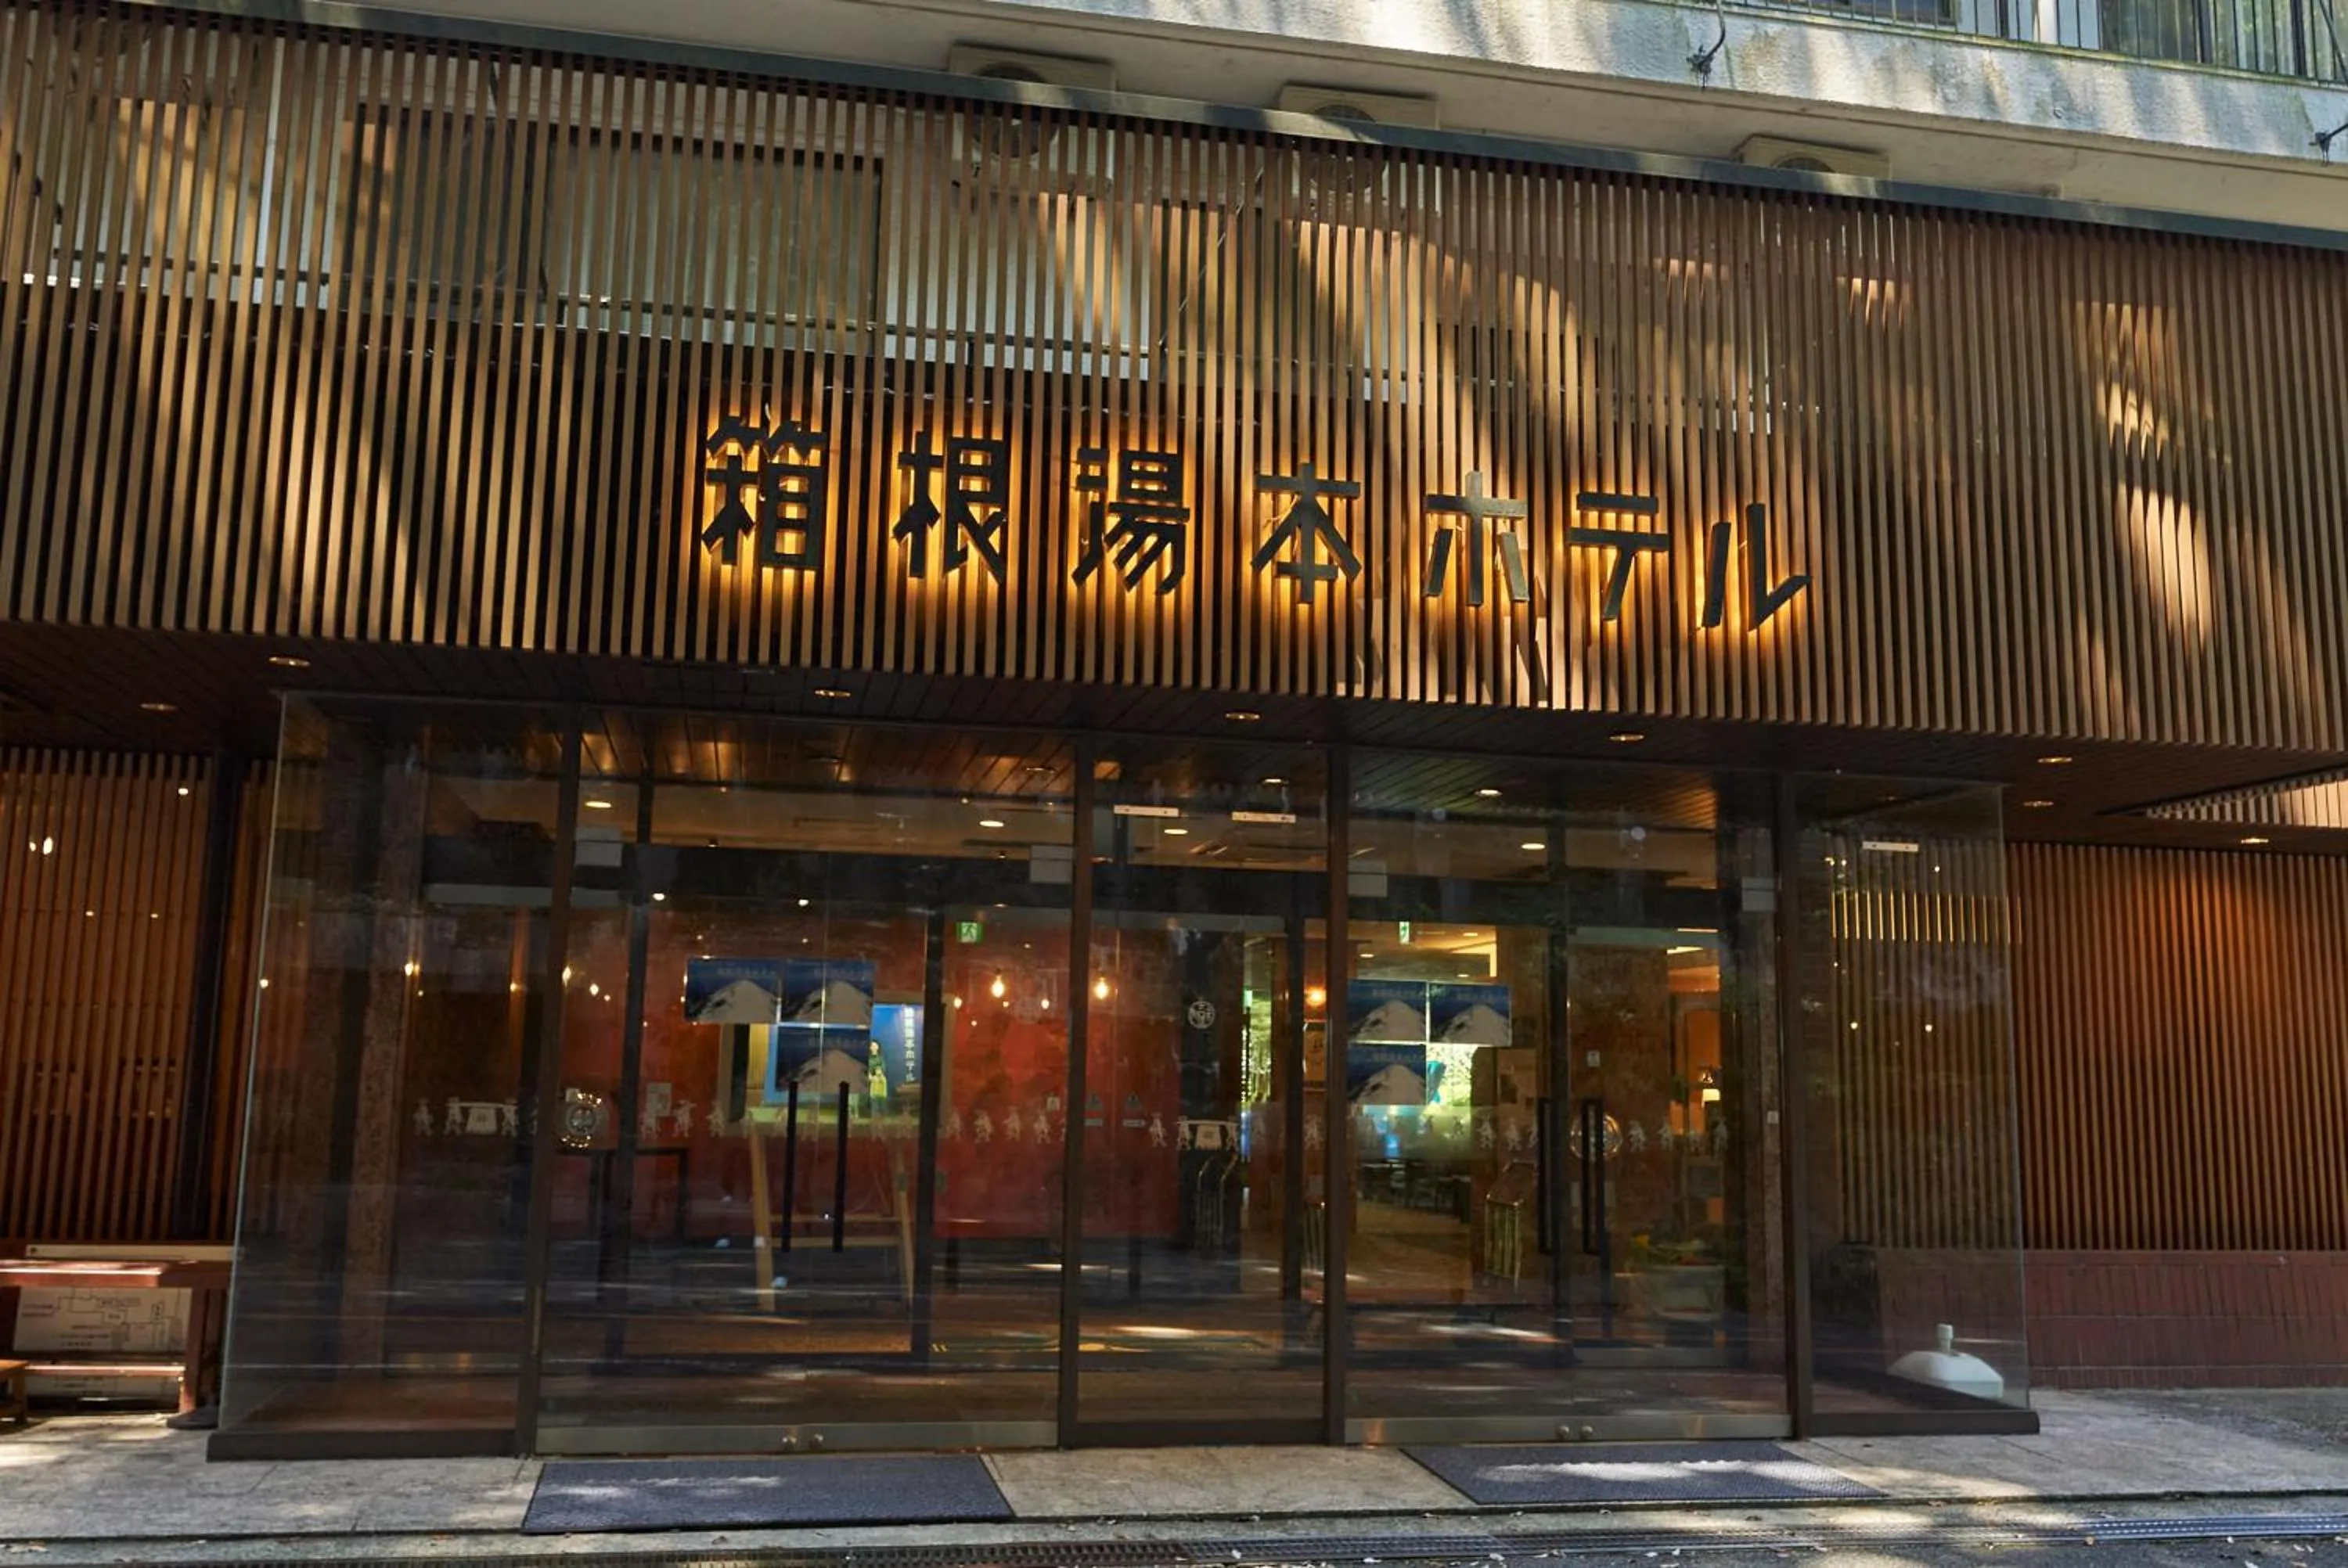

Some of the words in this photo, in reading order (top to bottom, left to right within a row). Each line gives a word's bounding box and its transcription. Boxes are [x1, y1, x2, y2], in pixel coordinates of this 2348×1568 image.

[700, 413, 1812, 631] 箱根湯本ホテル
